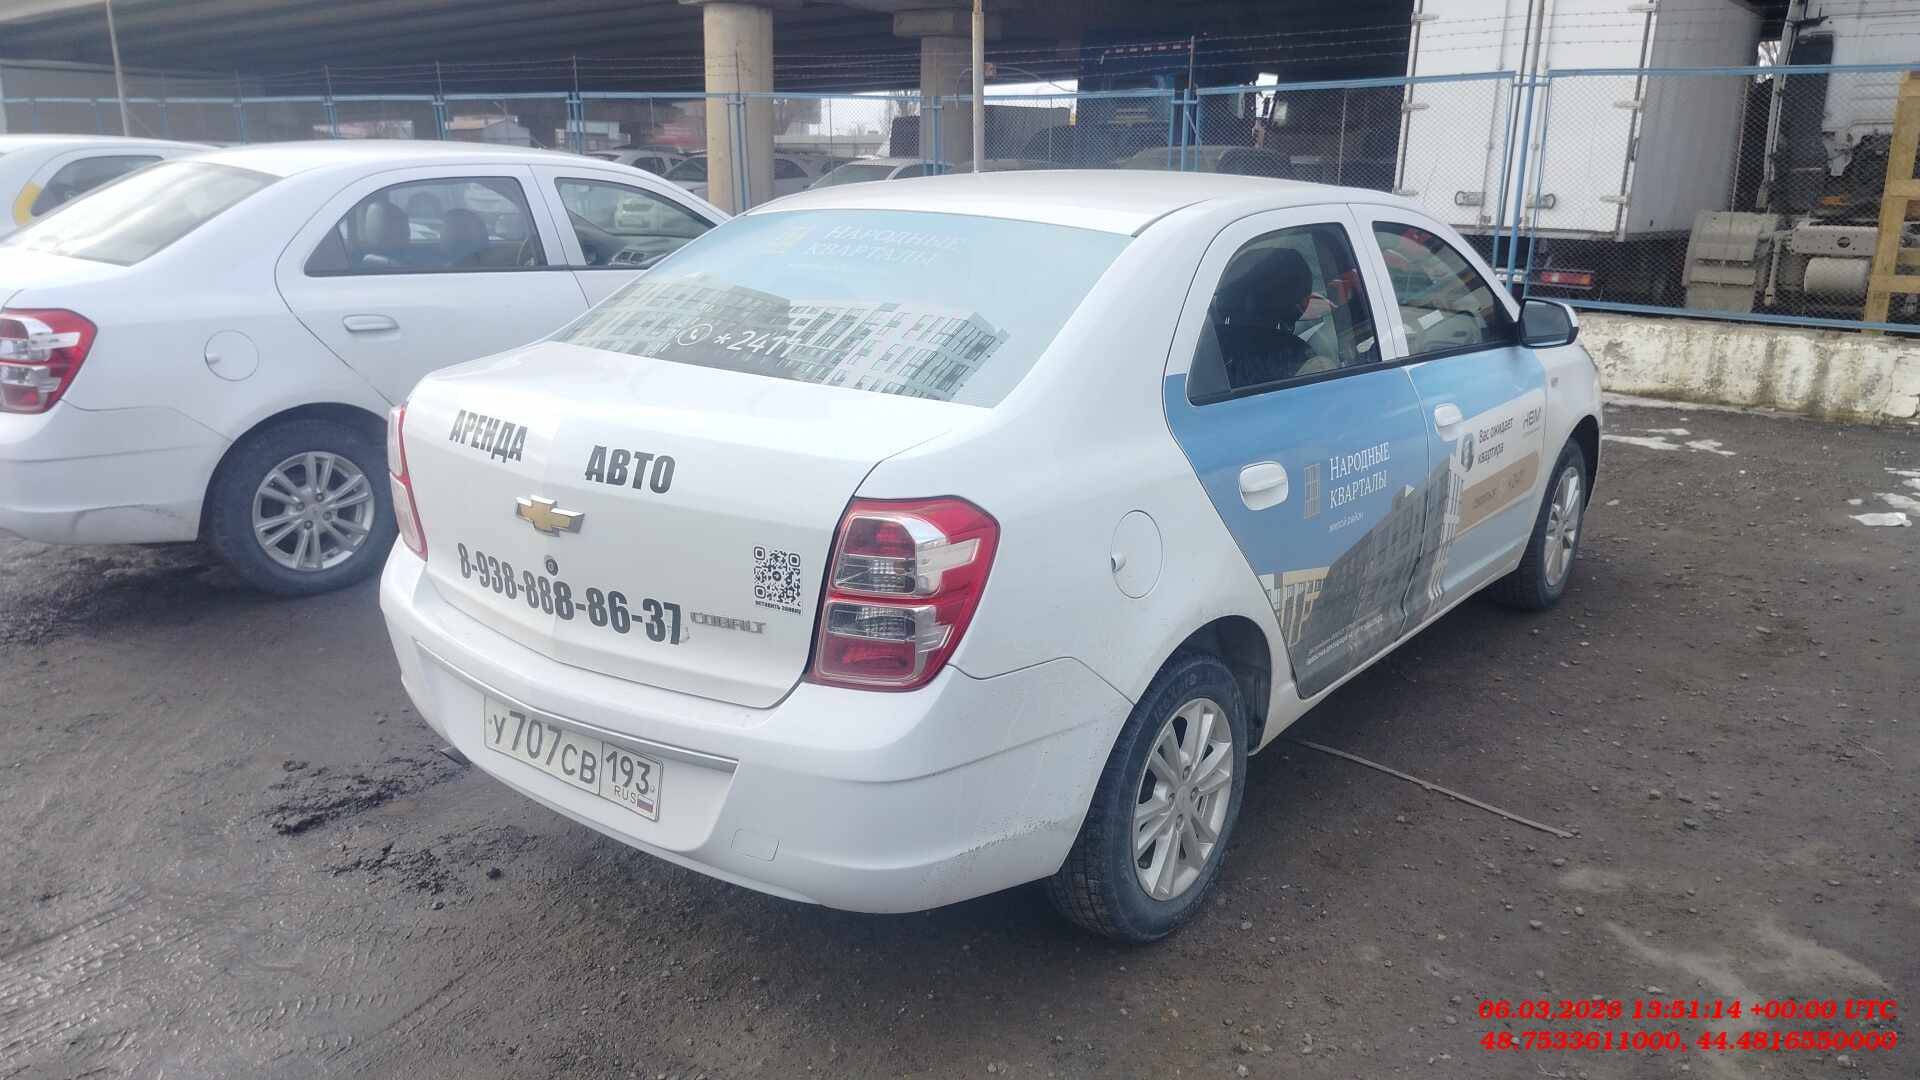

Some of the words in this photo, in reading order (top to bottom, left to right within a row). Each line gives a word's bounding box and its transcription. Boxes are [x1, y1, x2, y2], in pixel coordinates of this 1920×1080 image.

[449, 409, 528, 463] АРЕНДА
[584, 445, 676, 494] АВТО
[1329, 441, 1391, 481] НАРОДНЫЕ
[1329, 470, 1388, 509] КВАРТАЛЫ
[457, 542, 682, 645] 8-938-888-86-37
[690, 612, 767, 634] COBALT
[606, 751, 651, 794] 193
[614, 785, 637, 804] RUS
